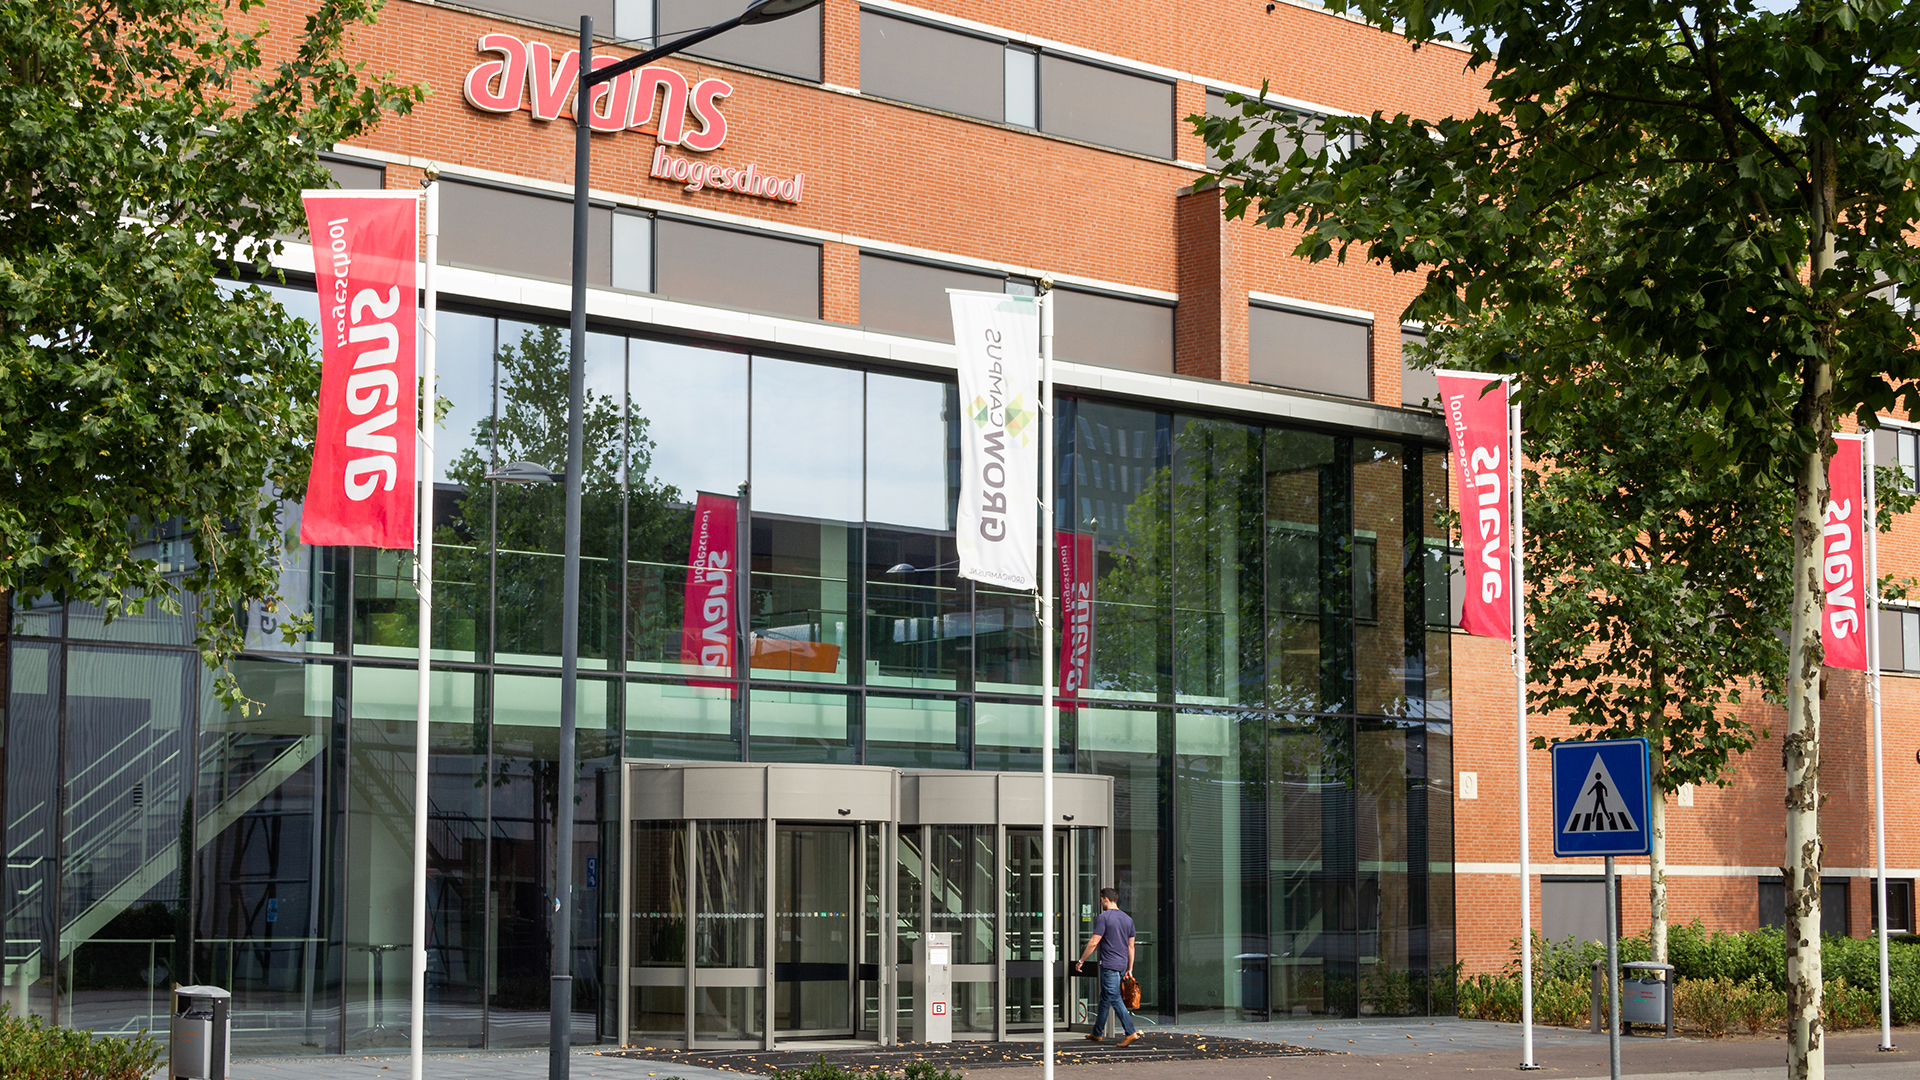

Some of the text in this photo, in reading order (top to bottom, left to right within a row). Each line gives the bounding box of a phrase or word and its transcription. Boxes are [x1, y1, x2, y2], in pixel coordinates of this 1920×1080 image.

[463, 33, 733, 151] avans
[650, 145, 805, 203] hogeschool
[936, 1005, 942, 1013] B
